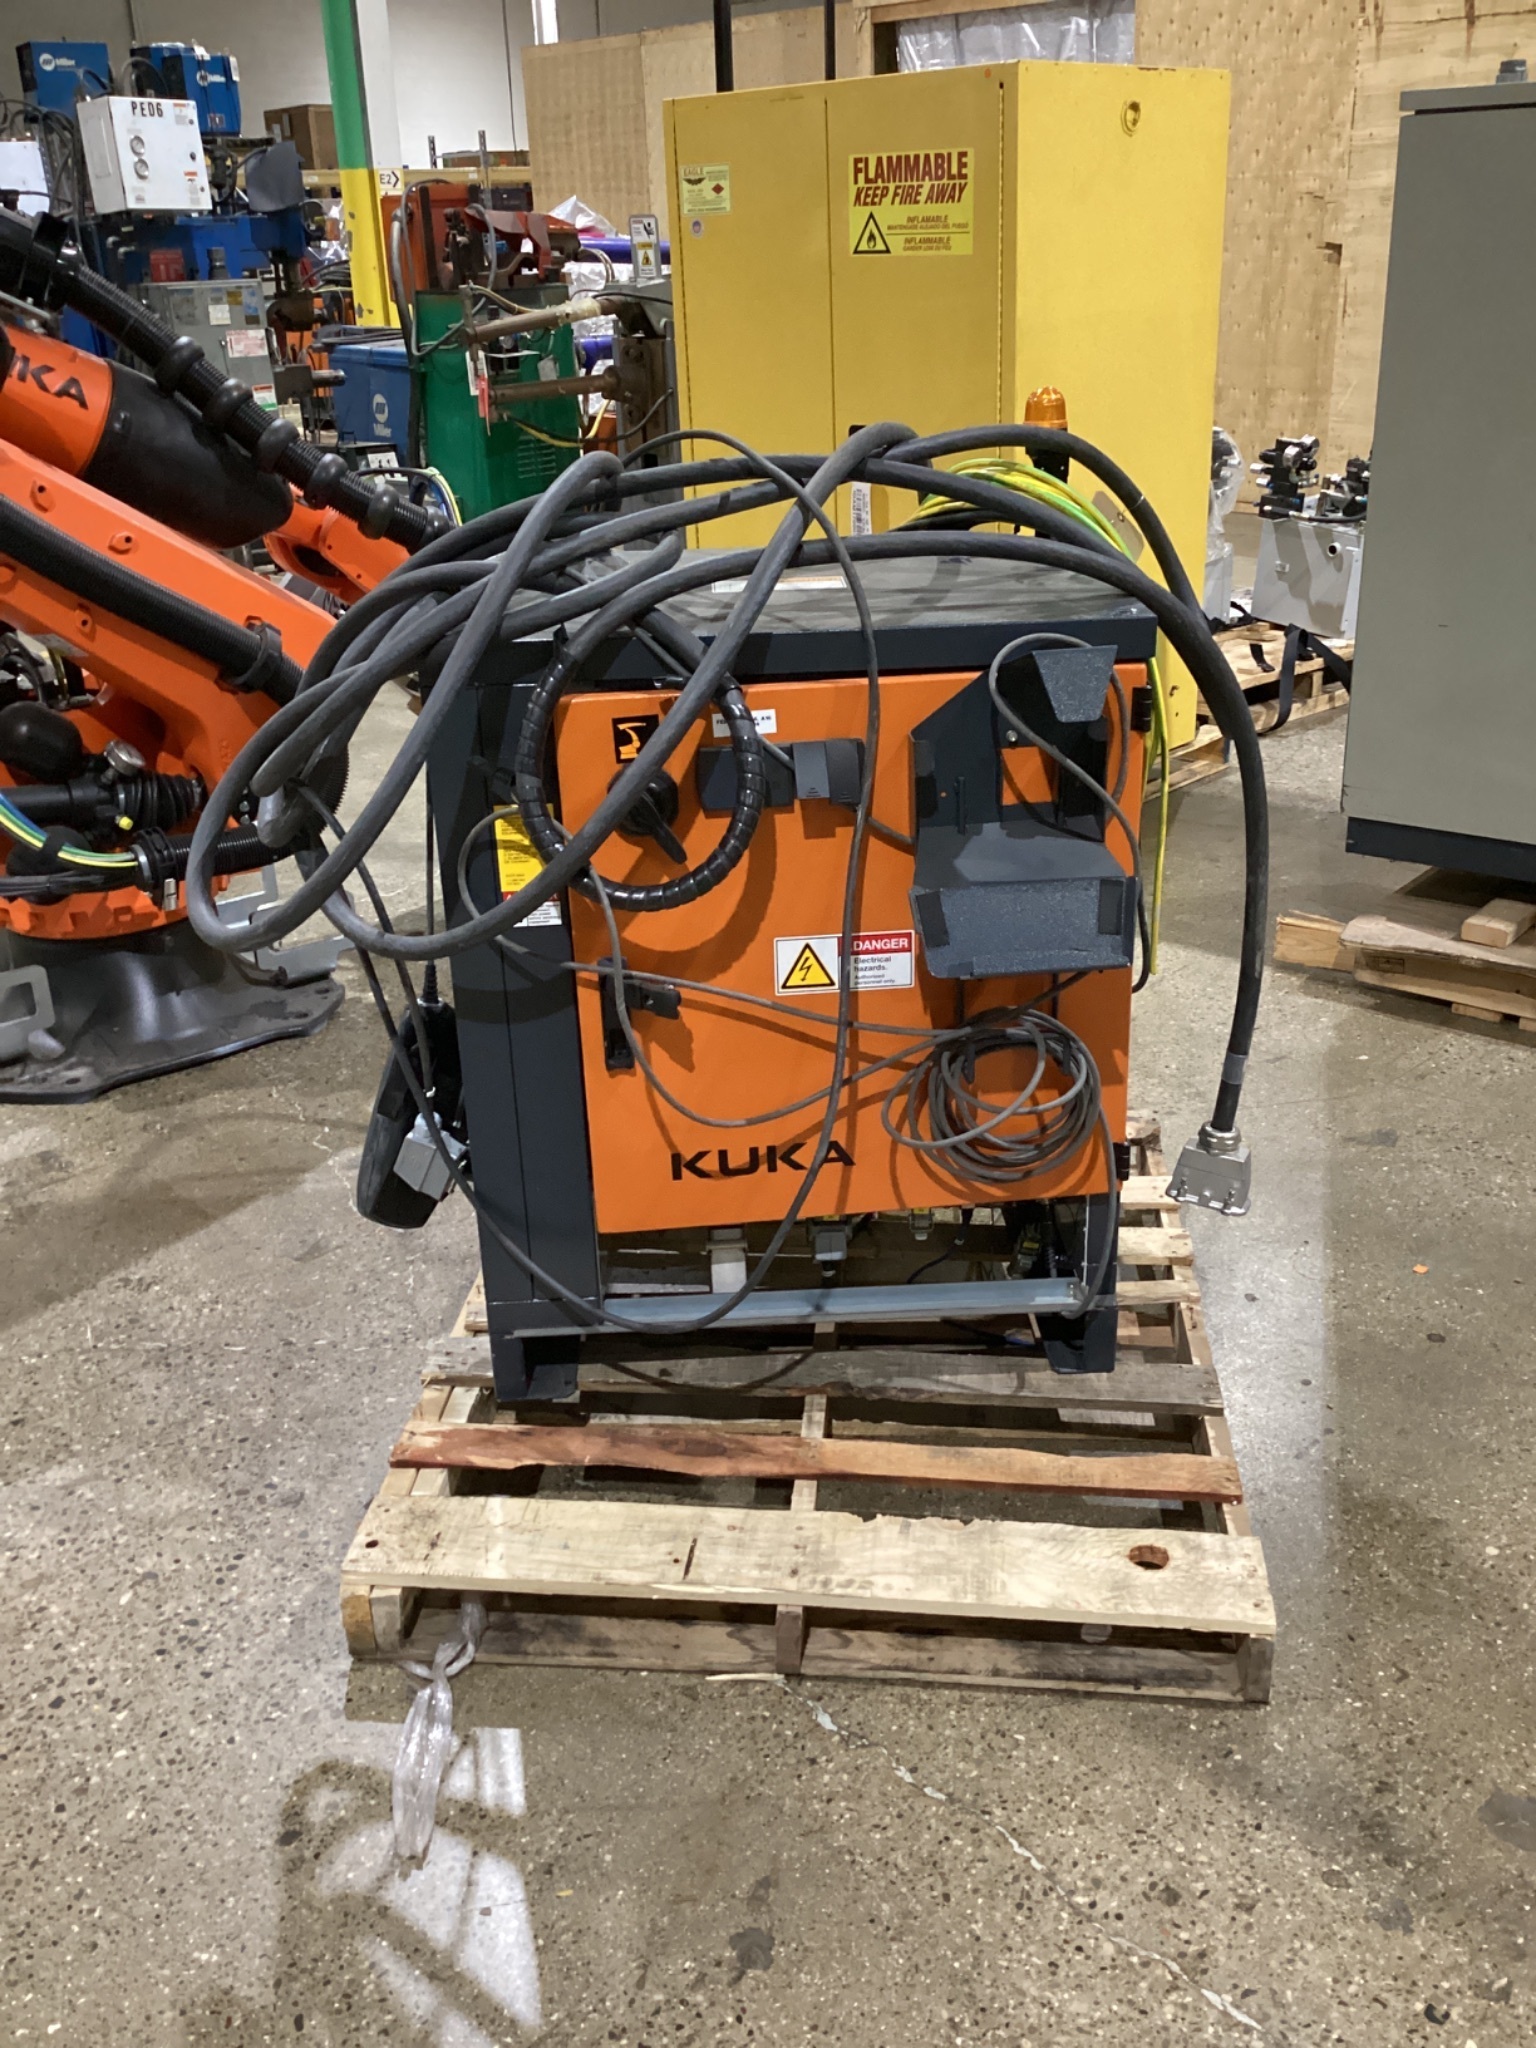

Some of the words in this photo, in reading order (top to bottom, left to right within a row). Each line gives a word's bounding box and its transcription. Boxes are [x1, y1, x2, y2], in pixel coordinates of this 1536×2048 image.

[131, 101, 164, 118] PED6
[853, 151, 968, 185] FLAMMABLE
[379, 173, 392, 185] E2
[853, 186, 890, 207] KEEP
[891, 184, 924, 206] FIRE
[924, 182, 968, 204] AWAY
[854, 938, 908, 951] DANGER
[854, 956, 891, 964] Electrical
[671, 1140, 857, 1181] KUKA
